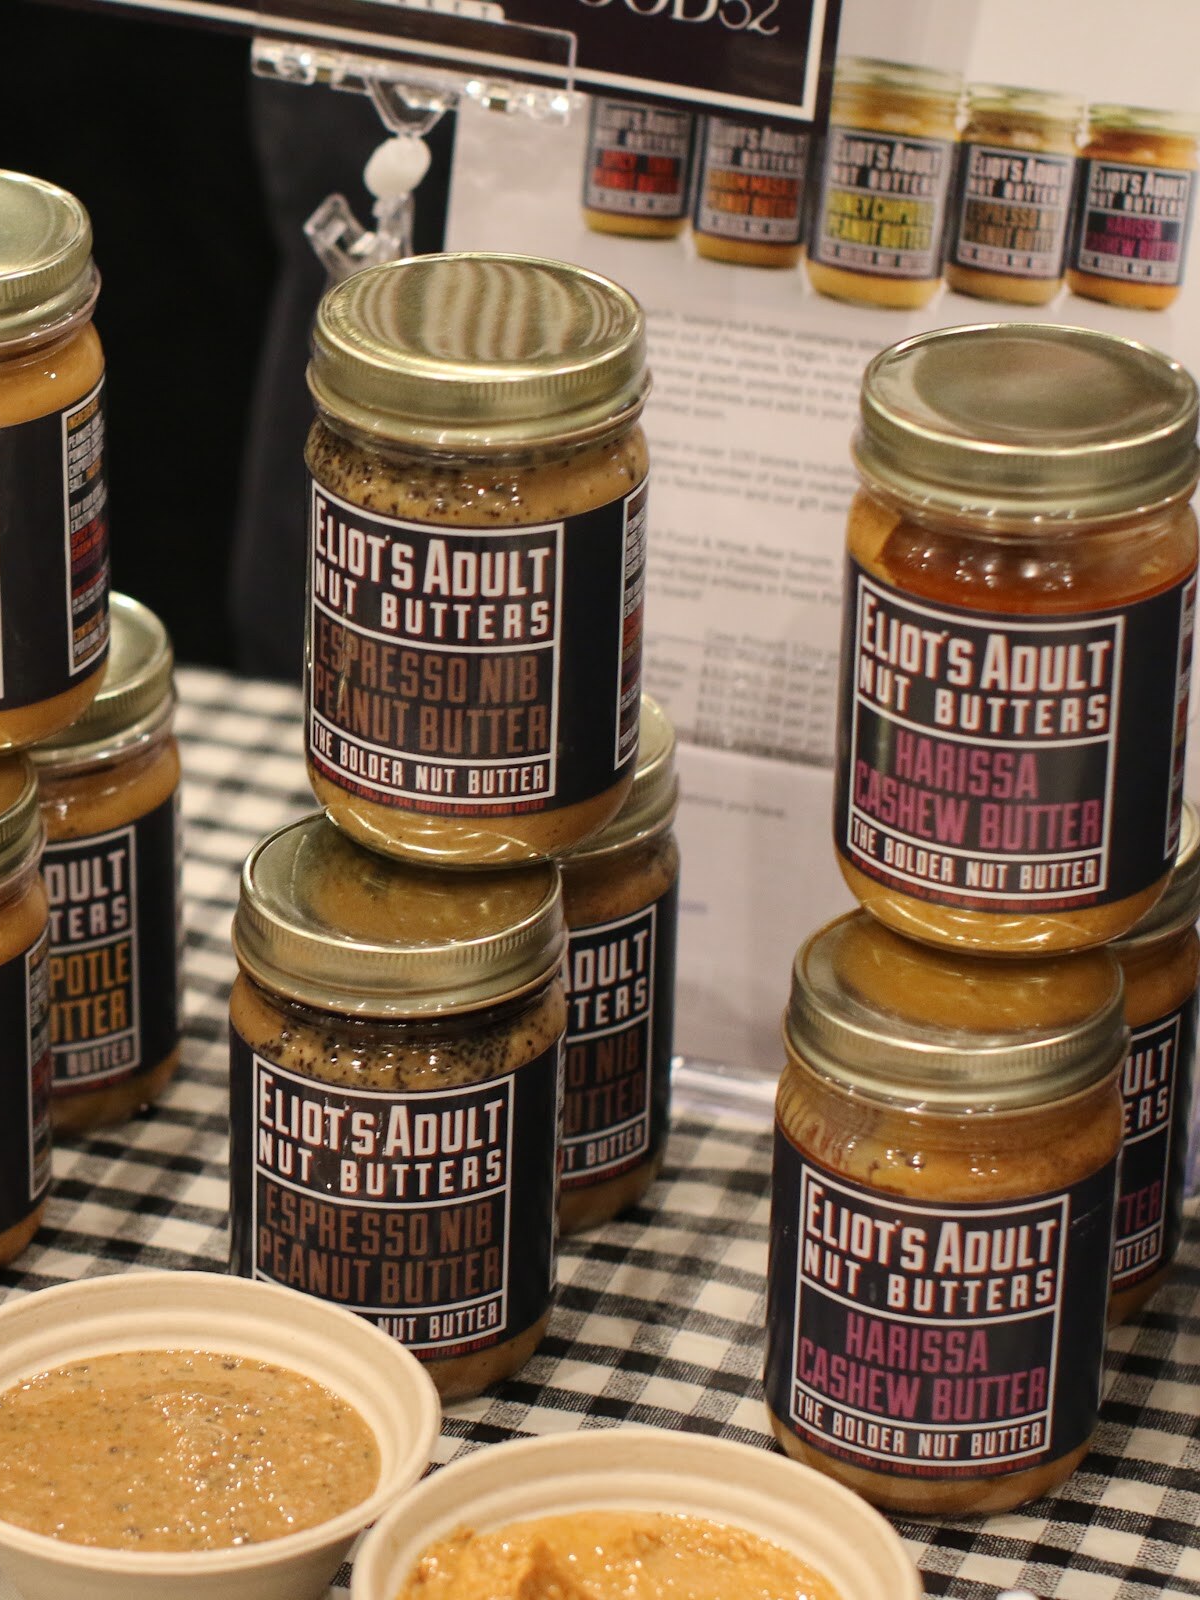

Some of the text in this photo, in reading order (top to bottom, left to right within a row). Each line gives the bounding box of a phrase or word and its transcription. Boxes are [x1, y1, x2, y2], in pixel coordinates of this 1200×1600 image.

[315, 495, 550, 598] ELIOT'S ADULT
[315, 561, 550, 641] NUT BUTTERS
[319, 615, 539, 704] ESPRESSO NIB
[861, 592, 1111, 693] ELIOT'S ADULT
[313, 662, 549, 755] PEANUT BUTTER
[859, 654, 911, 712] NUT
[934, 687, 1110, 735] BUTTERS
[313, 719, 334, 750] THE
[339, 739, 403, 786] BOLDER
[415, 765, 455, 794] NUT
[468, 764, 545, 794] BUTTER
[895, 729, 1040, 800] HARISSA
[855, 758, 1102, 851] CASHEW BUTTER
[44, 849, 126, 906] DULT
[853, 815, 877, 855] THE
[884, 838, 954, 883] BOLDER
[965, 861, 1008, 889] NUT
[1019, 858, 1098, 890] BUTTER
[50, 895, 129, 944] TERS
[50, 941, 130, 999] POTLE
[574, 976, 648, 1030] TERS
[567, 1070, 645, 1133] UTTER
[1123, 1037, 1173, 1096] ULT
[258, 1069, 503, 1159] ELIOT'S ADULT
[586, 1122, 643, 1166] BUTTER
[258, 1131, 313, 1184] NUT
[339, 1148, 502, 1197] BUTTERS
[265, 1181, 494, 1258] ESPRESSO NIB
[806, 1179, 1058, 1276] ELIOT'S ADULT
[1119, 1179, 1162, 1234] TER
[259, 1227, 501, 1305] PEANUT BUTTER
[804, 1237, 1056, 1315] NUT BUTTERS
[1113, 1231, 1158, 1272] UTTER
[377, 1302, 499, 1342] NUT BUTTER
[845, 1311, 989, 1374] HARISSA
[800, 1336, 1047, 1423] CASHEW BUTTER
[797, 1389, 823, 1429] THE
[832, 1411, 906, 1455] BOLDER
[918, 1431, 961, 1458] NUT
[970, 1420, 1042, 1458] BUTTER
